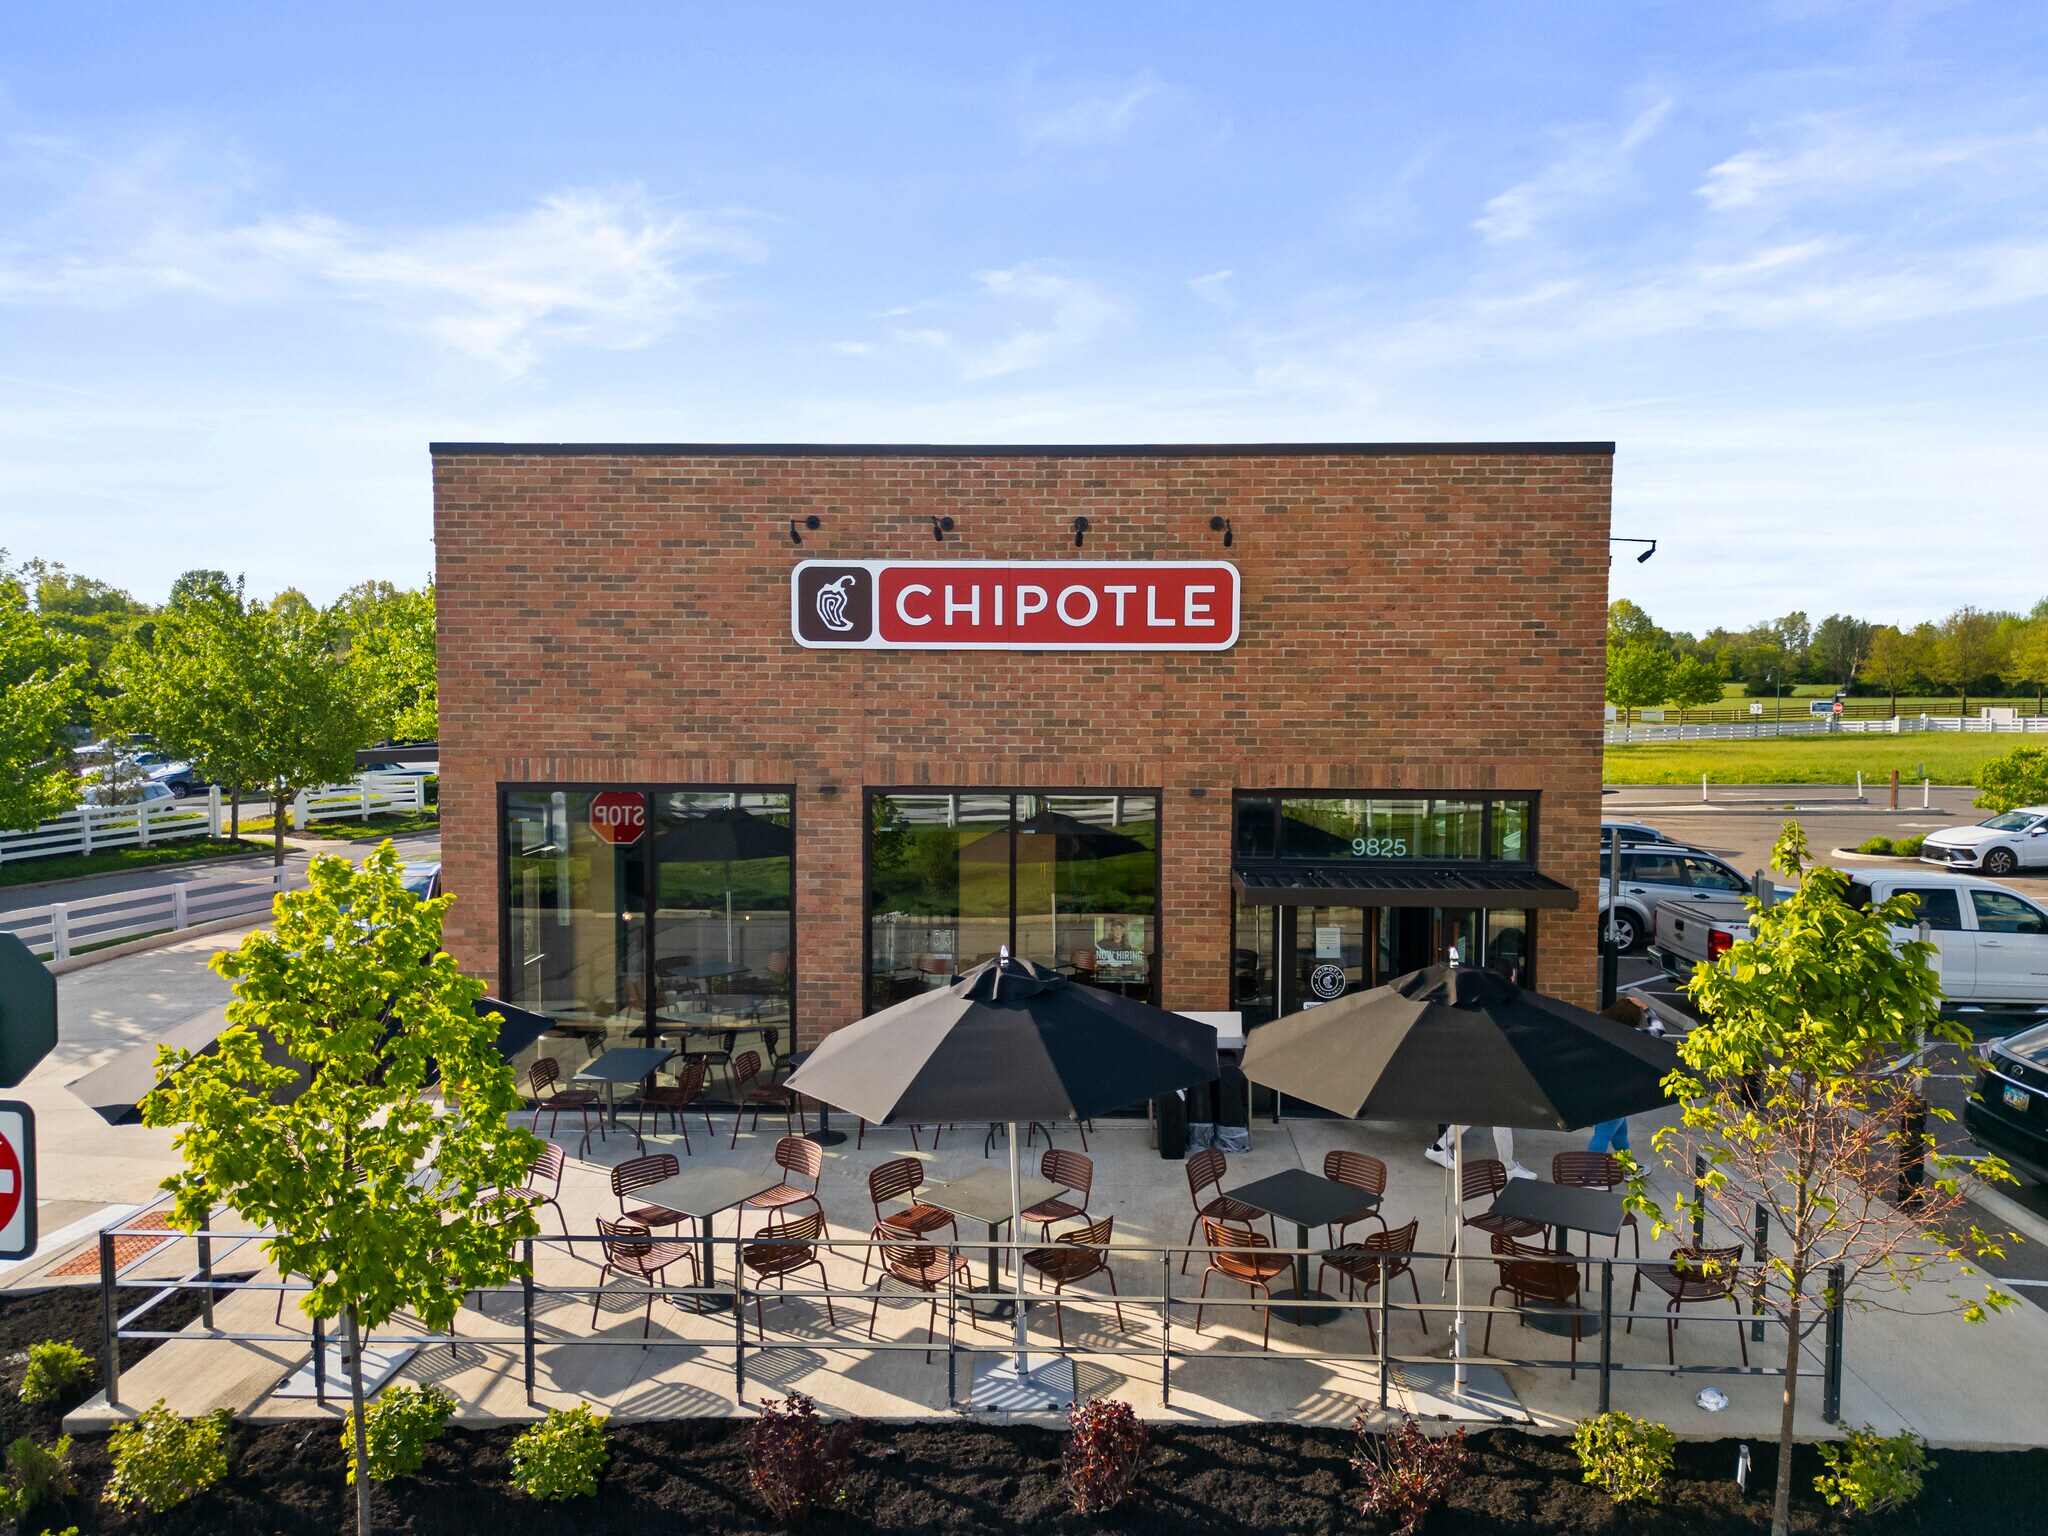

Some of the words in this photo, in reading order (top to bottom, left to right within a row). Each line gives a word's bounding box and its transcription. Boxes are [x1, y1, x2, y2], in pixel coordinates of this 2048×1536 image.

[896, 584, 1216, 627] CHIPOTLE
[1352, 838, 1407, 857] 9825
[1096, 950, 1115, 960] NOW
[1116, 950, 1143, 960] HIRING
[1314, 966, 1343, 979] CHIPOTLE
